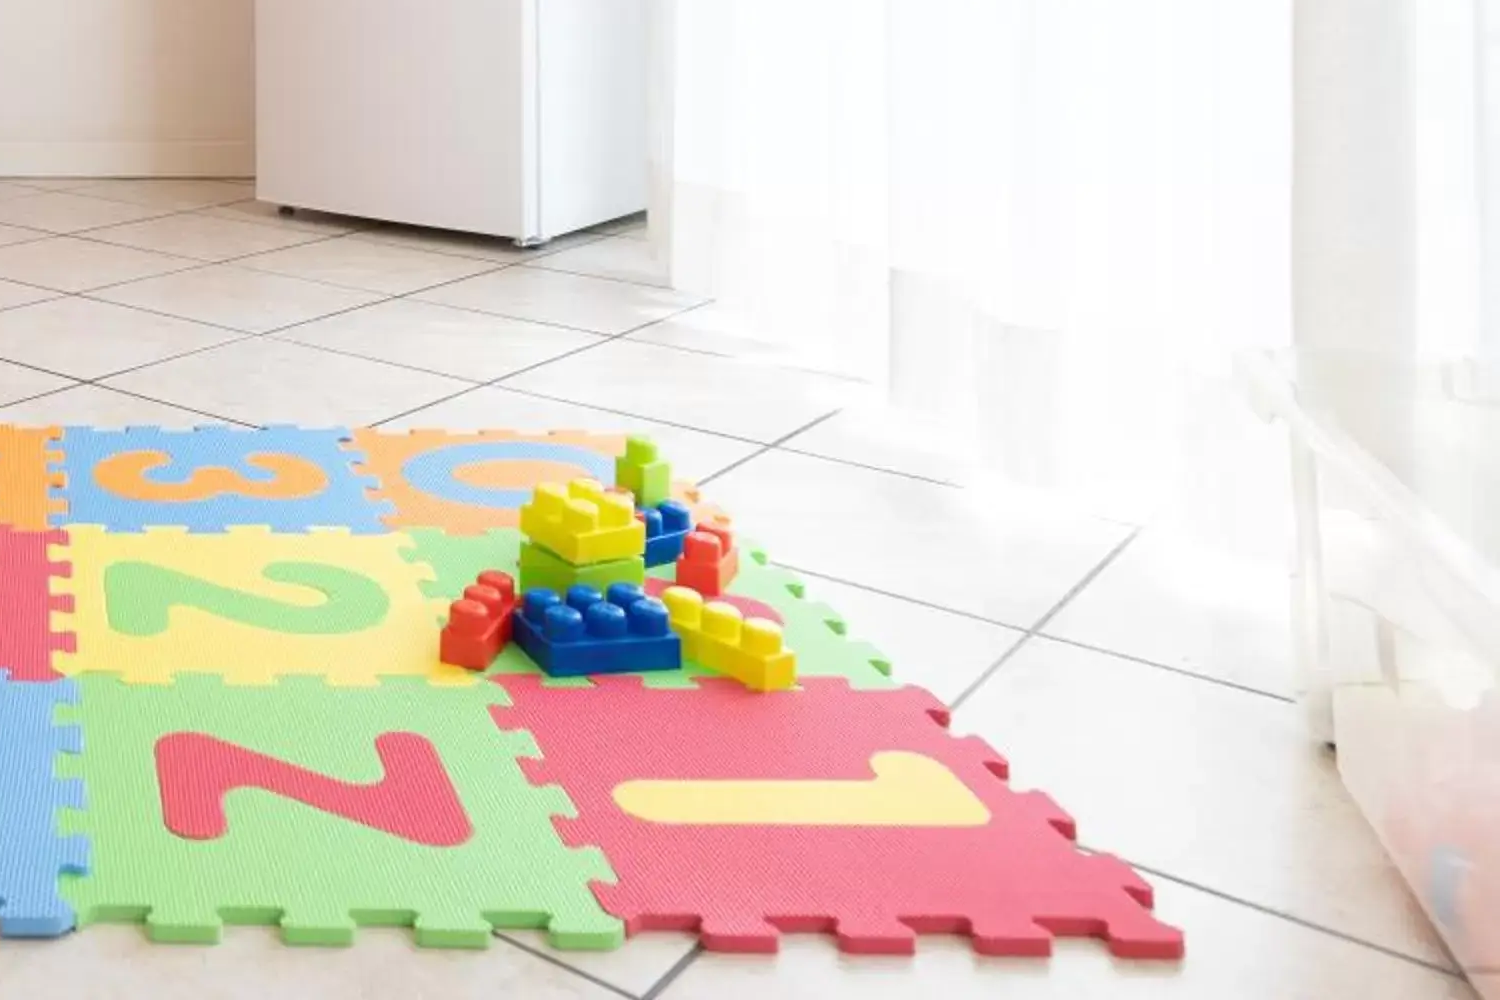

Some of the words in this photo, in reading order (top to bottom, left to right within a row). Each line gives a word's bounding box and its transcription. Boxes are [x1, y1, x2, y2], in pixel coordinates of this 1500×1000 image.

[94, 450, 328, 502] 3
[104, 560, 390, 636] 2
[154, 730, 475, 847] Z
[611, 750, 992, 827] 1
